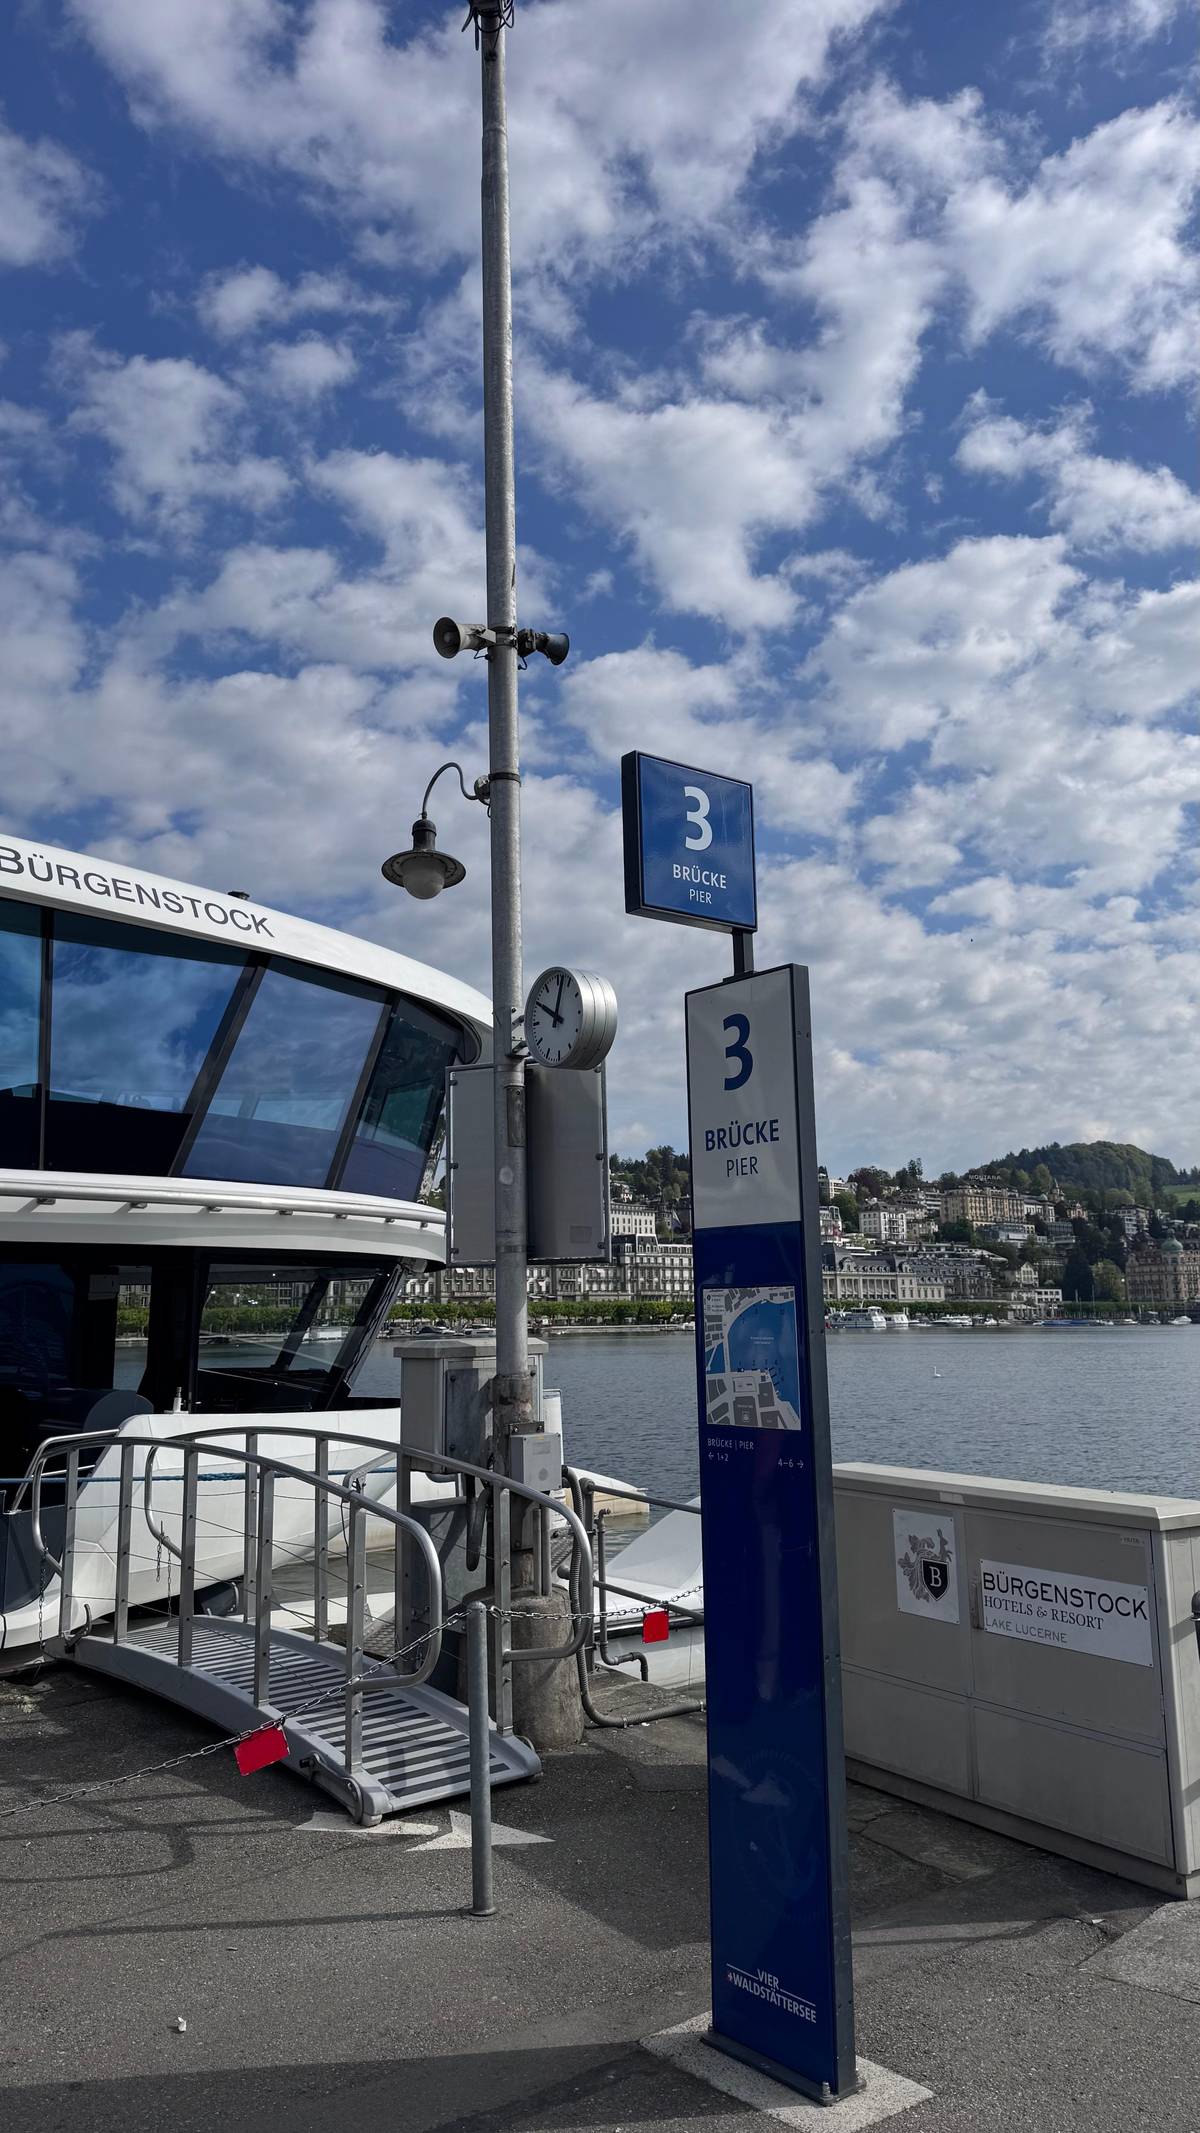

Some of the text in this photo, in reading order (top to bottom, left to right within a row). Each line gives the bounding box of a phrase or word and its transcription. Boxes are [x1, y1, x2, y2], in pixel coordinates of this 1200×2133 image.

[684, 786, 713, 850] 3
[673, 864, 726, 889] BRÜCKE
[0, 846, 275, 938] BÜRGENSTOCK
[689, 889, 712, 904] PIER
[723, 1013, 753, 1091] 3
[705, 1119, 780, 1151] BRÜCKE
[726, 1156, 759, 1178] PIER
[707, 1437, 733, 1448] BRÜCKE
[739, 1440, 754, 1450] PIER
[716, 1452, 729, 1462] 1+2
[930, 1566, 942, 1587] B
[983, 1571, 1148, 1620] BÜRGENSTOCK
[984, 1595, 1104, 1630] HOTELS & RESORT
[985, 1616, 1068, 1643] LAKE LUCERNE
[757, 1968, 780, 1990] VIER
[733, 1972, 817, 2024] WALDSTÄTTERSEE
